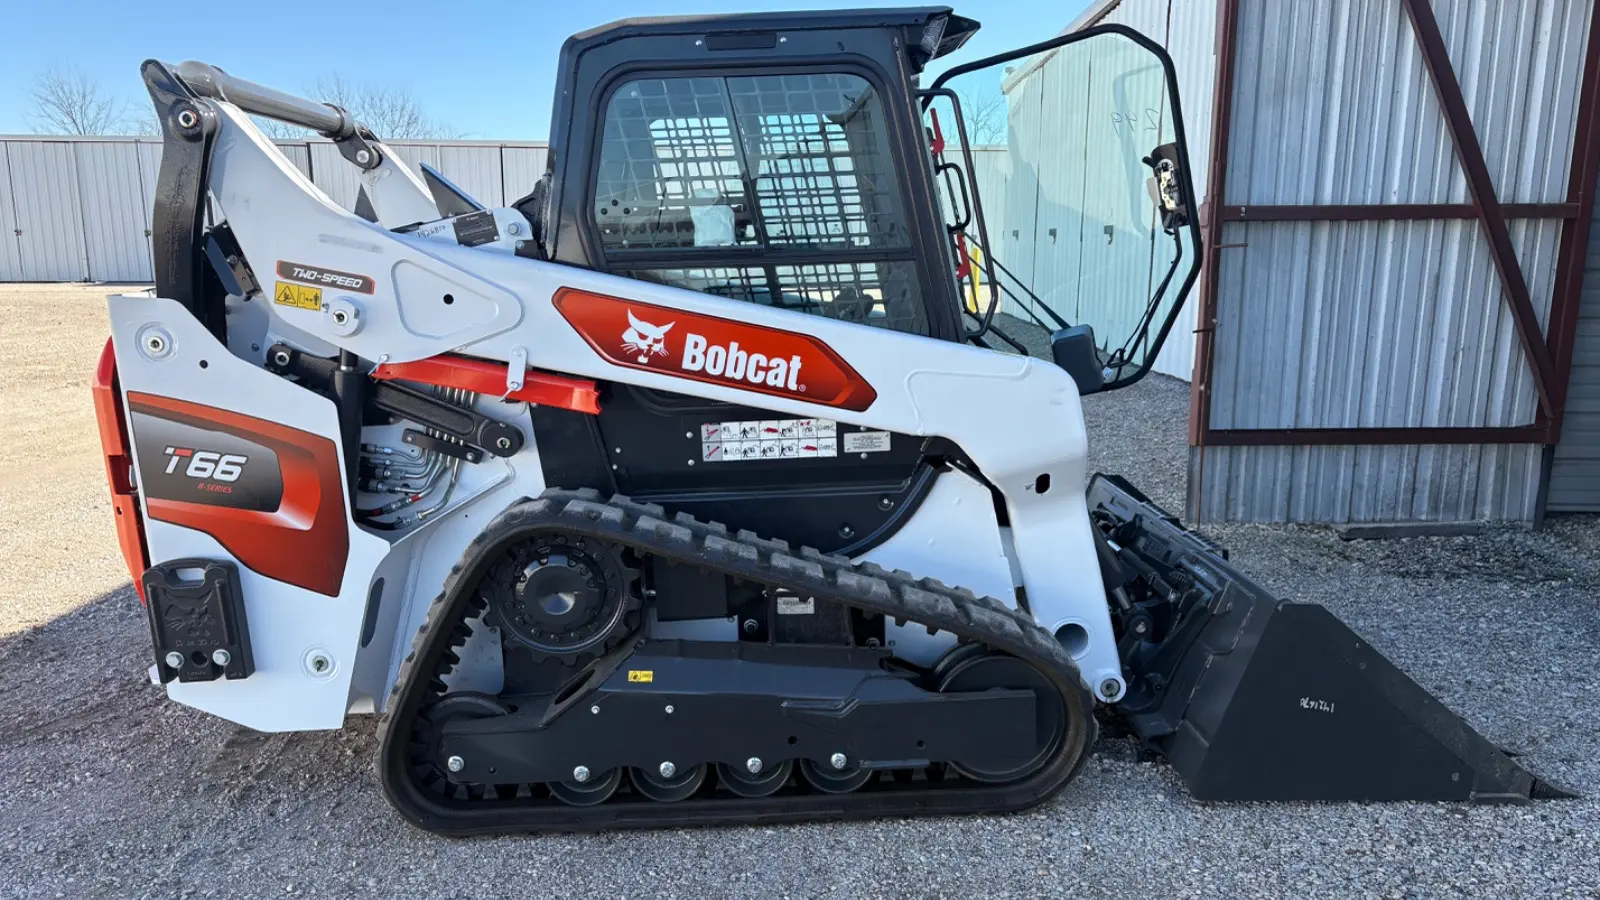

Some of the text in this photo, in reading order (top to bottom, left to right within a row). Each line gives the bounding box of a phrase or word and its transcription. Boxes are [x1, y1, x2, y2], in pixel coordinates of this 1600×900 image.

[293, 267, 363, 289] TWO-SPEED
[681, 332, 802, 391] Bobcat
[164, 446, 248, 482] T66
[197, 482, 233, 494] R-SERIES
